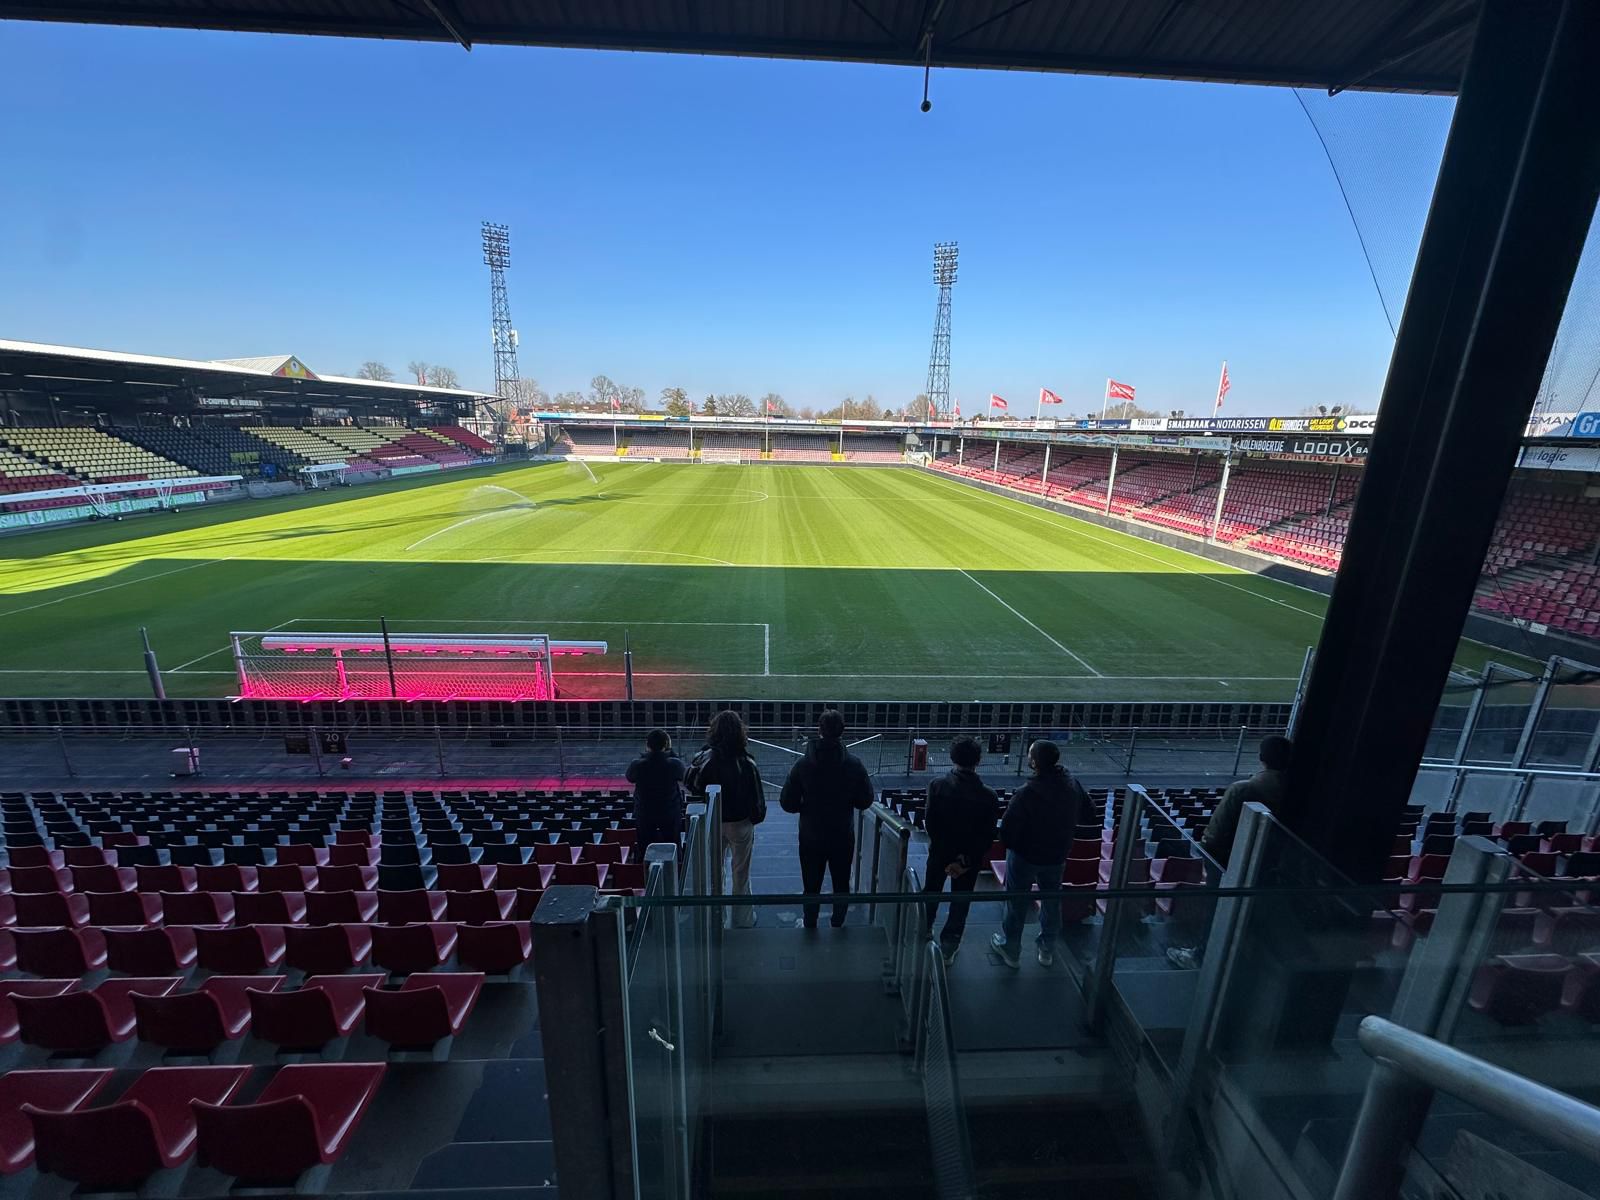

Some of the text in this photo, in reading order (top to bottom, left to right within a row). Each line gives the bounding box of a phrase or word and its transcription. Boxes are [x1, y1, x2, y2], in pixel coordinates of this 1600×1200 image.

[1168, 419, 1267, 429] SMALBRAAK NOTARISSEN
[1240, 439, 1285, 452] KOLENBOERTJE
[325, 733, 339, 742] 20
[996, 734, 1005, 742] 19
